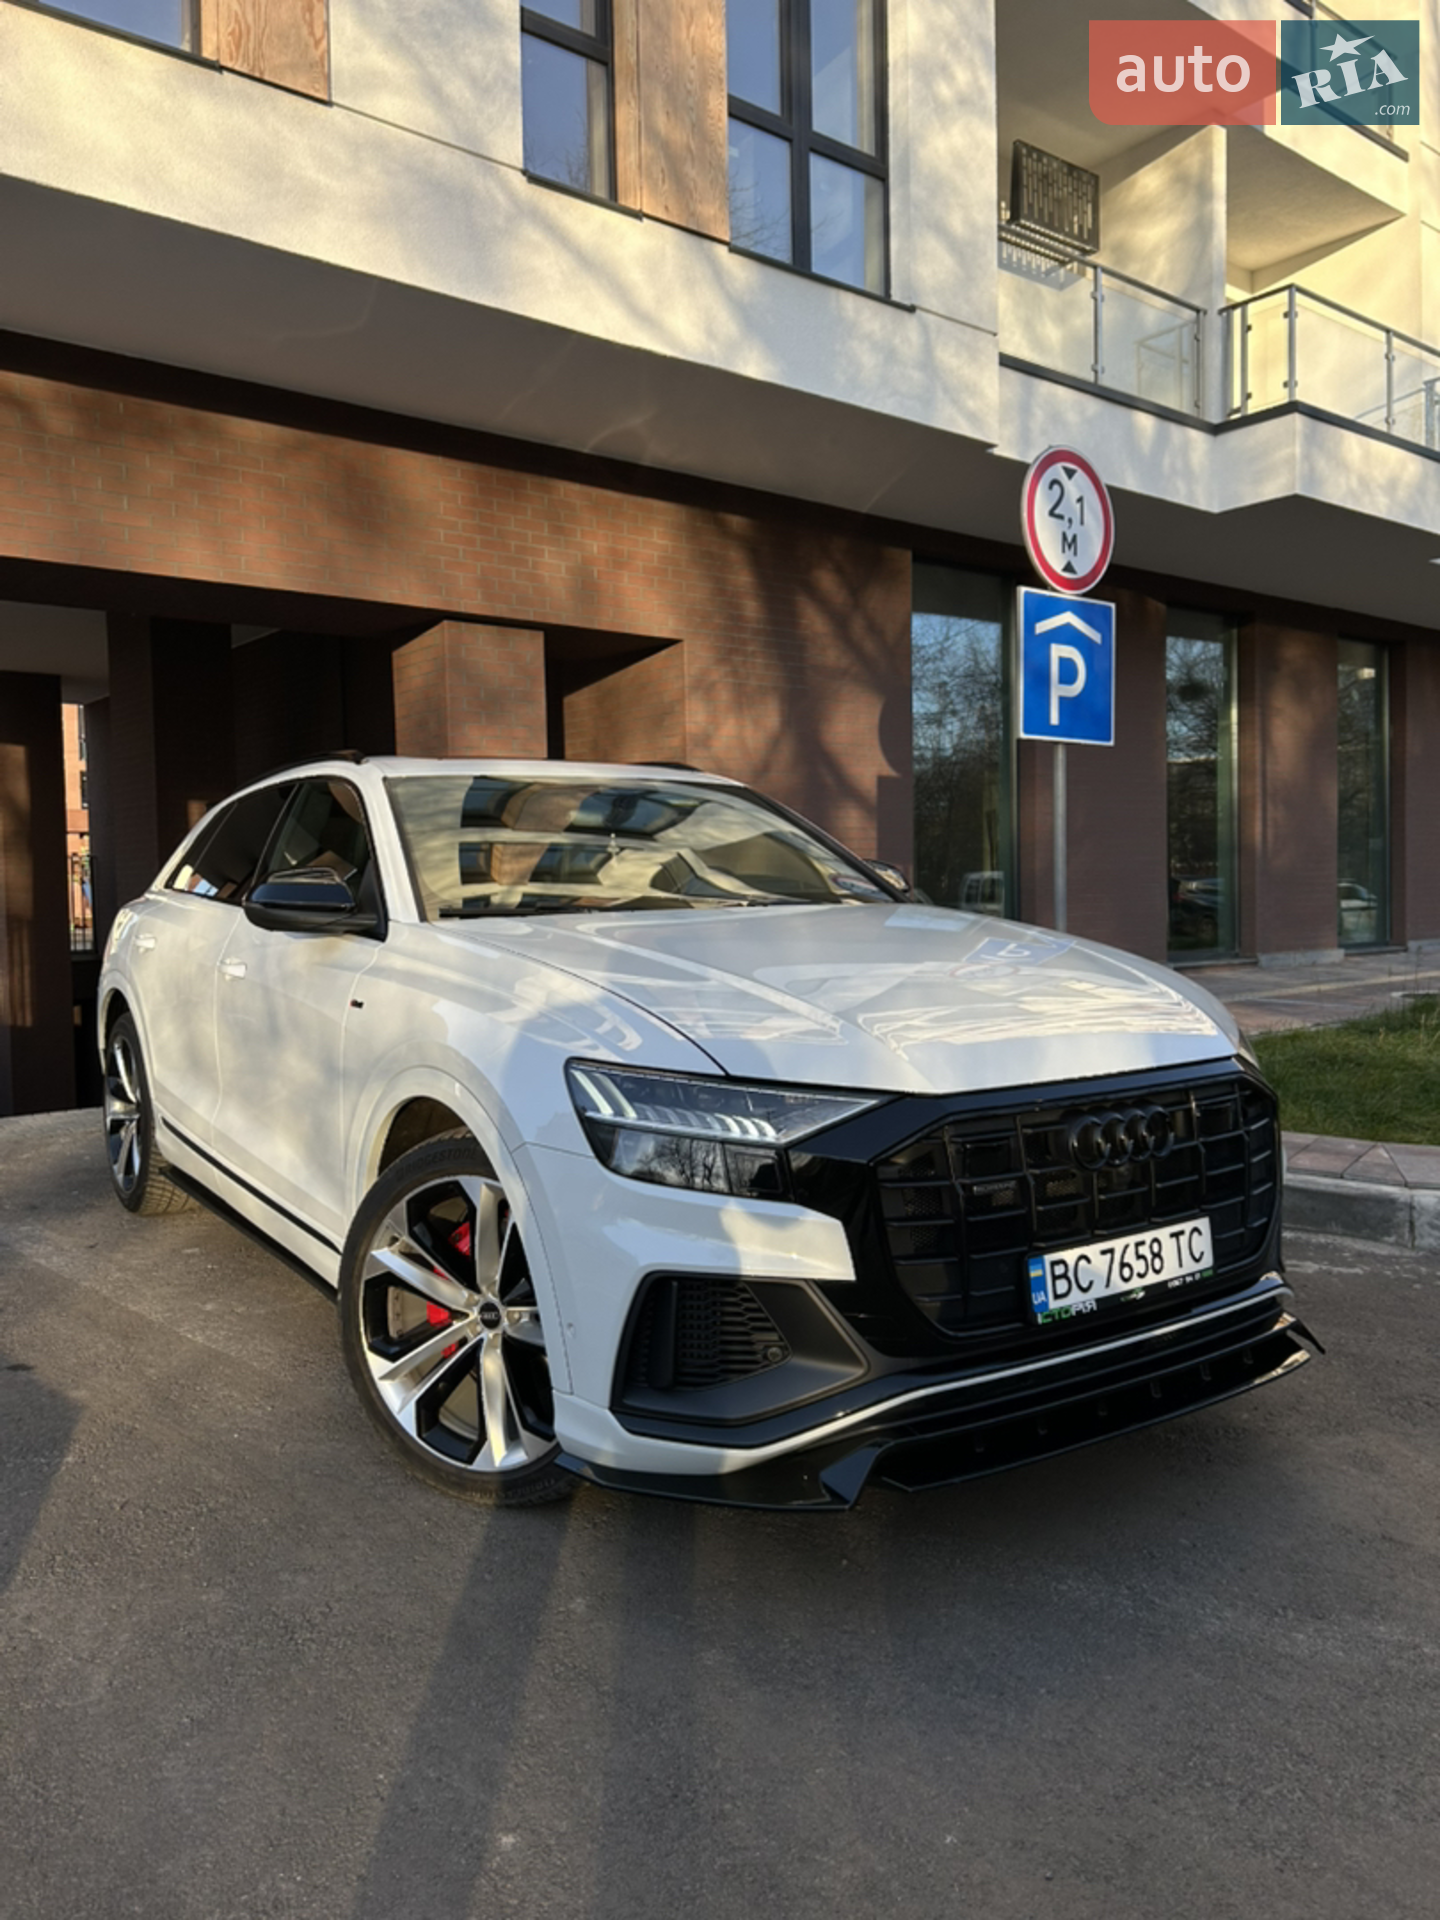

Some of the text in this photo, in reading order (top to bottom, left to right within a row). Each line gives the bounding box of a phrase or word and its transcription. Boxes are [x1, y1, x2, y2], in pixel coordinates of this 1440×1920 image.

[1048, 478, 1085, 529] 2,1
[1049, 643, 1086, 726] P
[1050, 1253, 1094, 1301] BC
[1100, 1237, 1164, 1289] 7658
[1169, 1226, 1205, 1269] TC
[1032, 1291, 1047, 1305] UA
